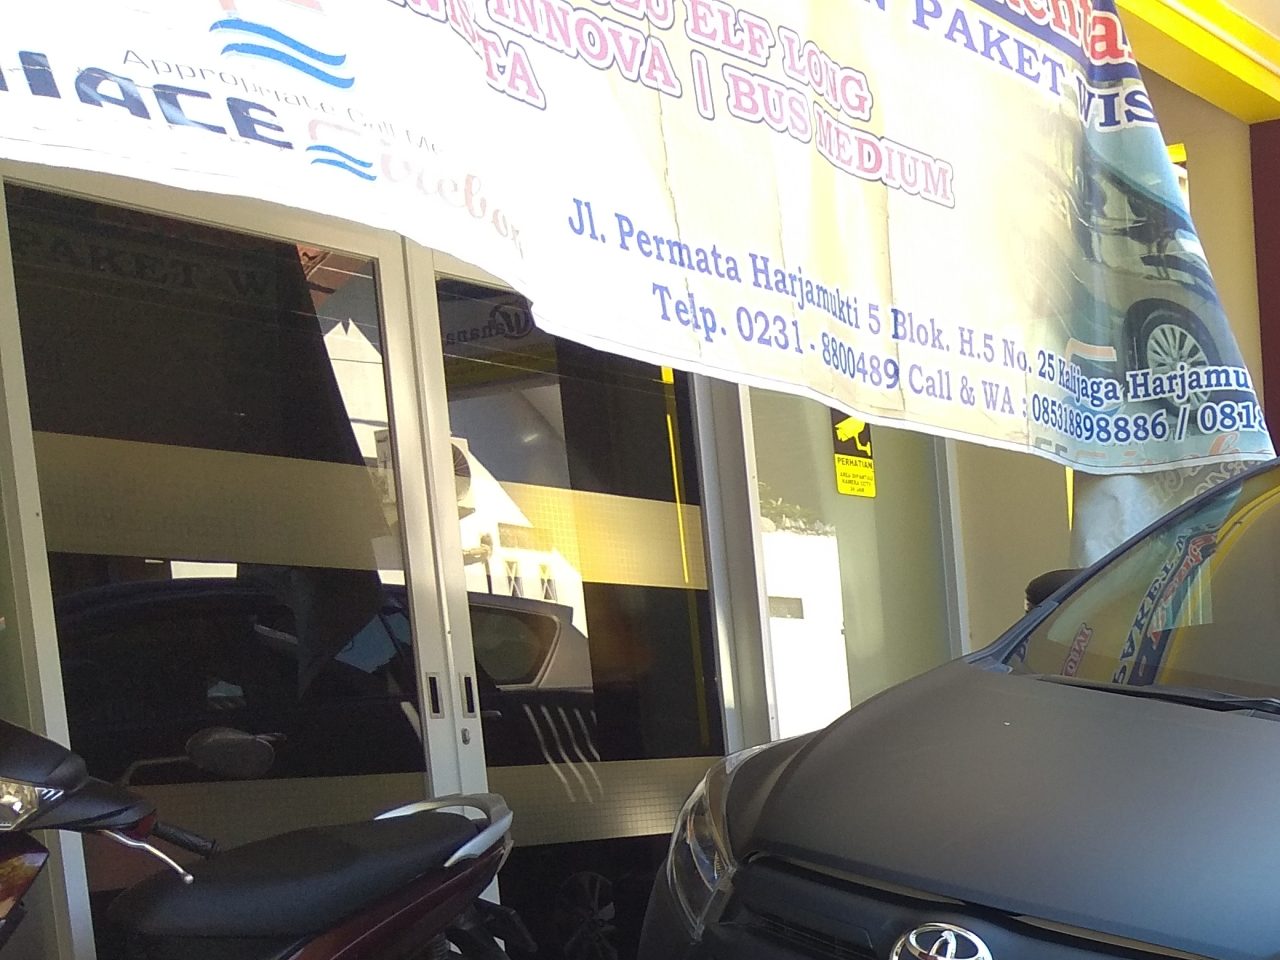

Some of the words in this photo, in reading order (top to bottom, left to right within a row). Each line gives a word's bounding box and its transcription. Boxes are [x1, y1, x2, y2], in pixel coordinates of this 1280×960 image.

[0, 50, 294, 150] IACE
[688, 0, 772, 61] ELF
[781, 30, 871, 117] LONG
[912, 0, 1066, 97] PAKET
[726, 68, 811, 138] BUS
[814, 105, 953, 204] MEDIUM
[568, 197, 607, 244] Jl.
[614, 212, 742, 284] Permata
[748, 252, 861, 331] Harjamukti
[867, 303, 881, 335] 5
[891, 308, 951, 352] Blok.
[957, 326, 996, 363] H.5
[1001, 338, 1033, 374] No.
[1037, 349, 1056, 382] 25
[651, 282, 728, 344] Telp.
[735, 306, 804, 355] 0231
[821, 331, 900, 389] 8800489
[908, 363, 953, 401] Call
[959, 375, 976, 407] &
[981, 379, 1016, 416] WA
[1031, 393, 1168, 443] 085318898886
